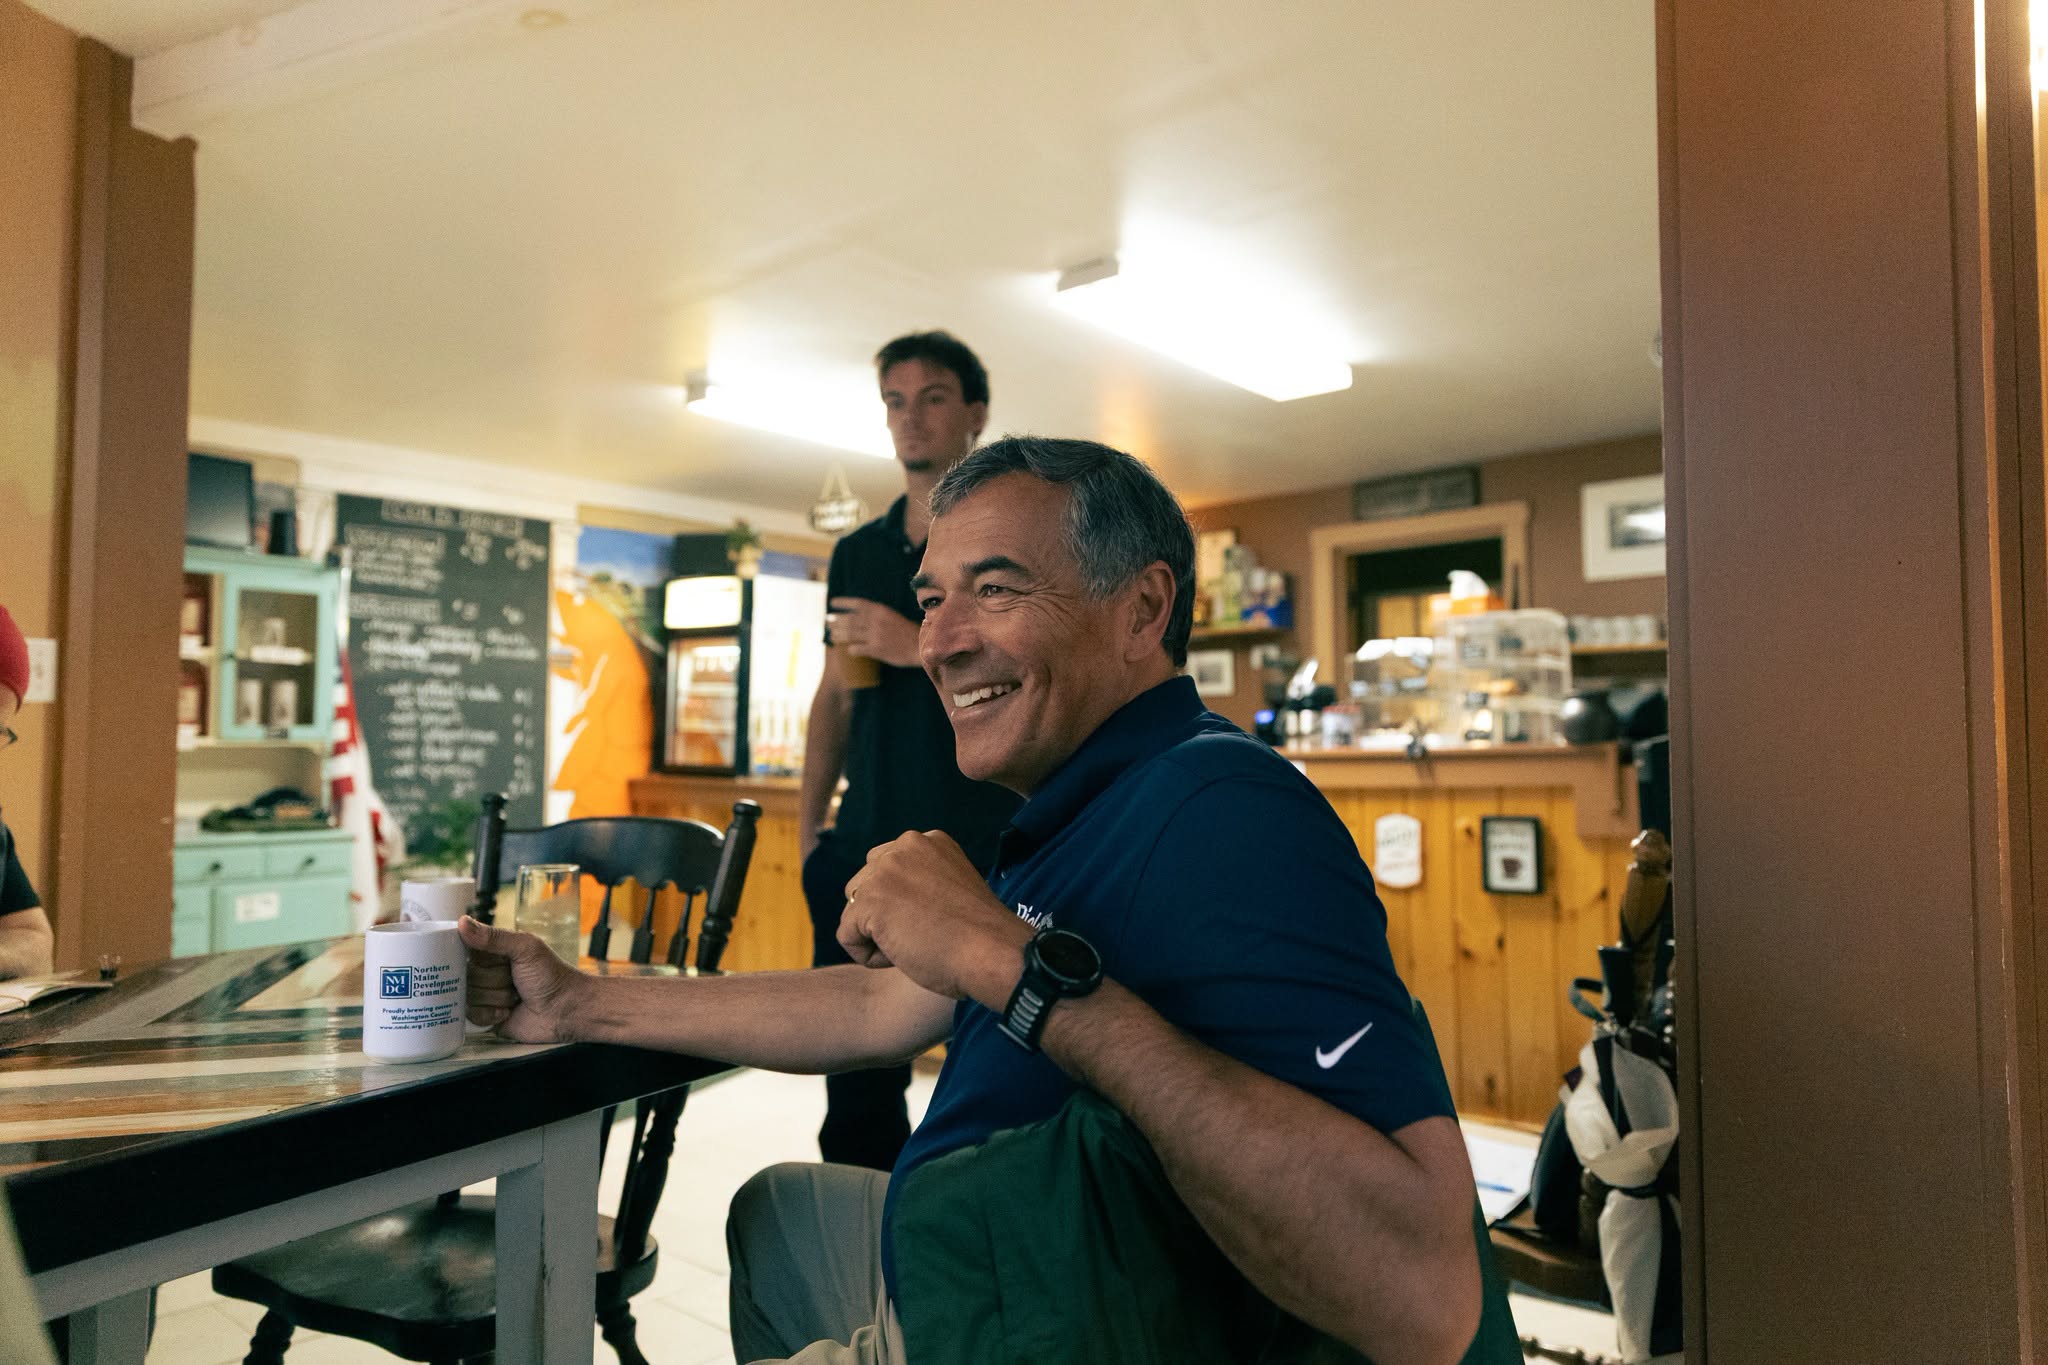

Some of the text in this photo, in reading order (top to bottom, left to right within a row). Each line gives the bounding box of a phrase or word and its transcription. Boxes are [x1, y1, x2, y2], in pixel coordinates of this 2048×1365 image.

[413, 965, 450, 973] Northern
[413, 974, 440, 982] Maine
[413, 977, 460, 989] Development
[385, 984, 405, 994] DC
[413, 986, 458, 997] Commission
[406, 1006, 433, 1014] brewing
